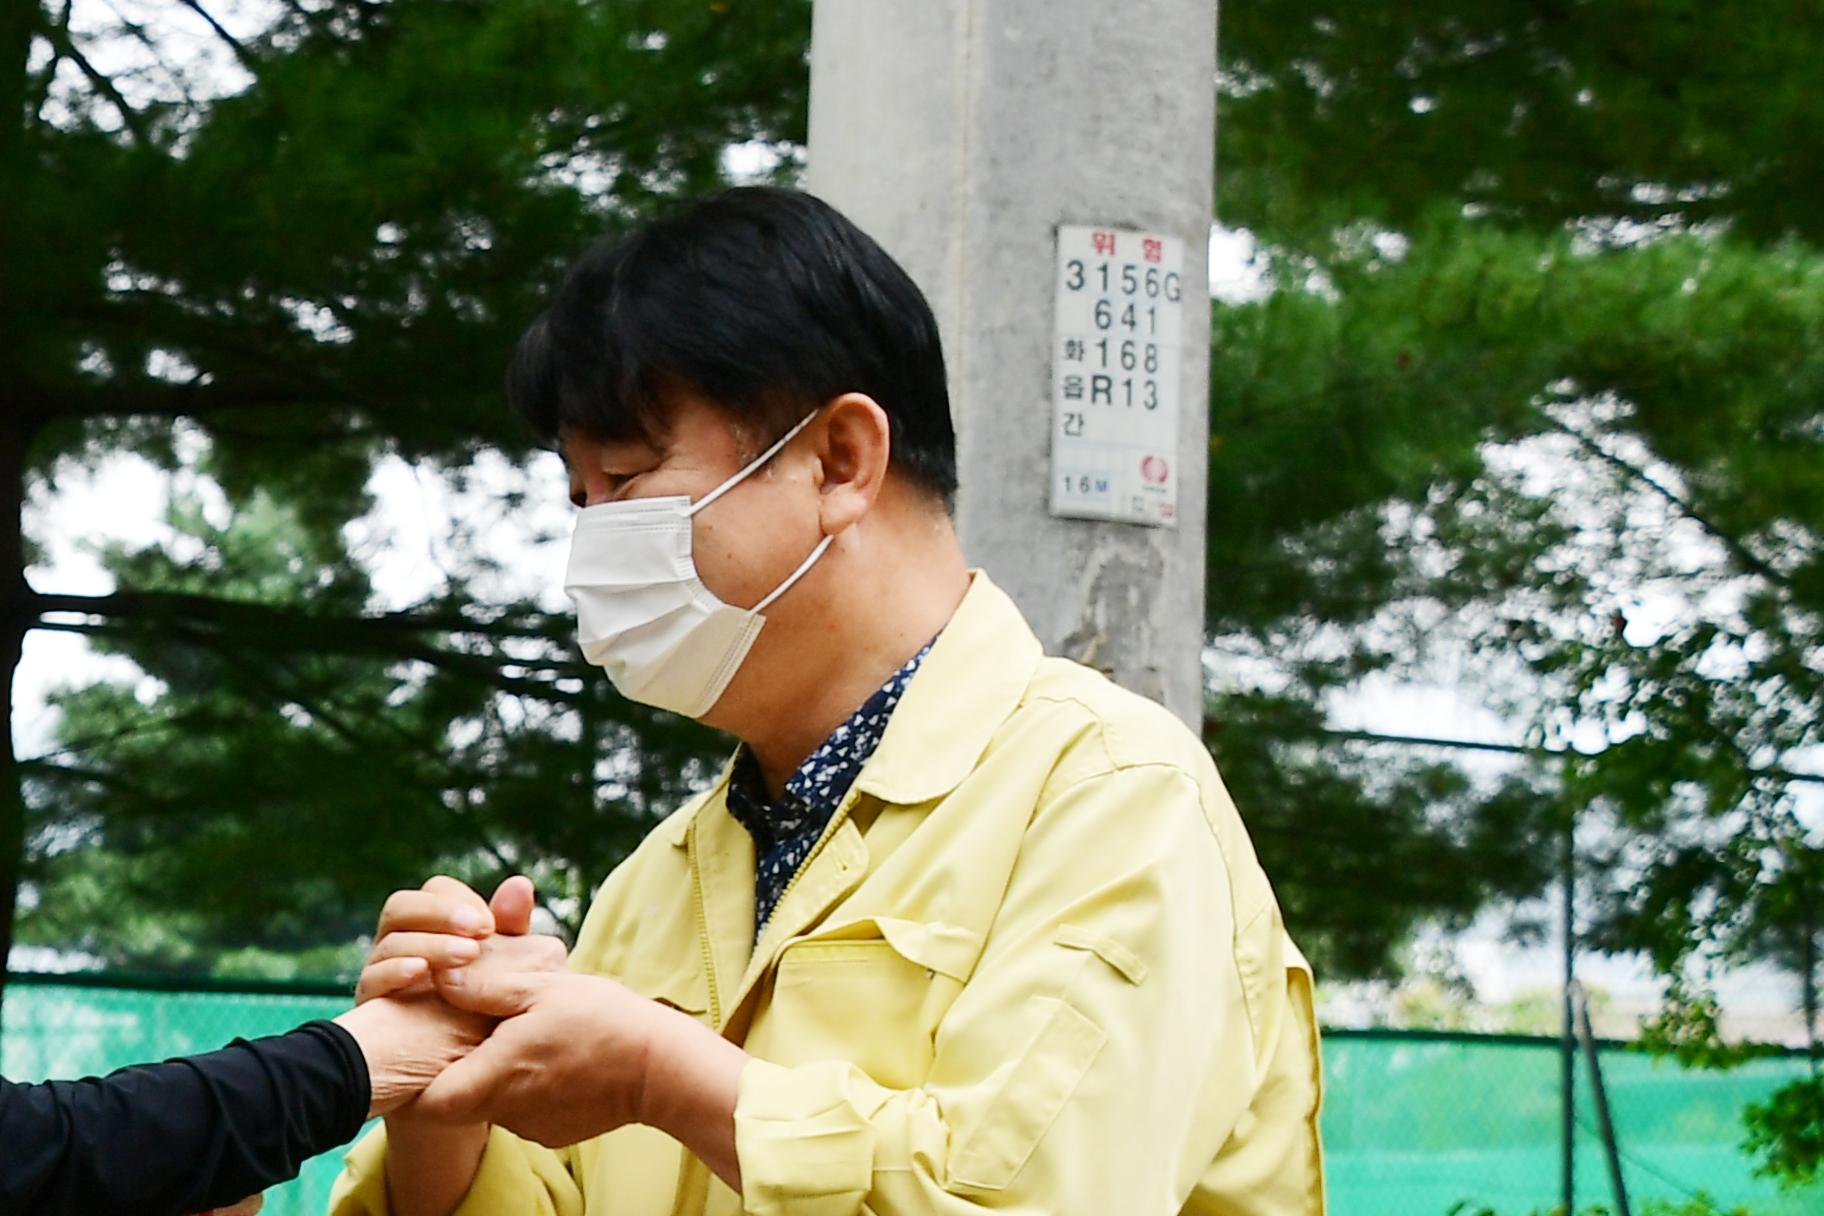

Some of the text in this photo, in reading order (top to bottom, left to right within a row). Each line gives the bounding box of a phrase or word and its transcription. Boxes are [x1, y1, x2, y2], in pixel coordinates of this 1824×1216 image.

[1066, 259, 1182, 303] 3156G
[1094, 299, 1158, 334] 641
[1095, 338, 1158, 373] 168
[1091, 374, 1158, 411] R13
